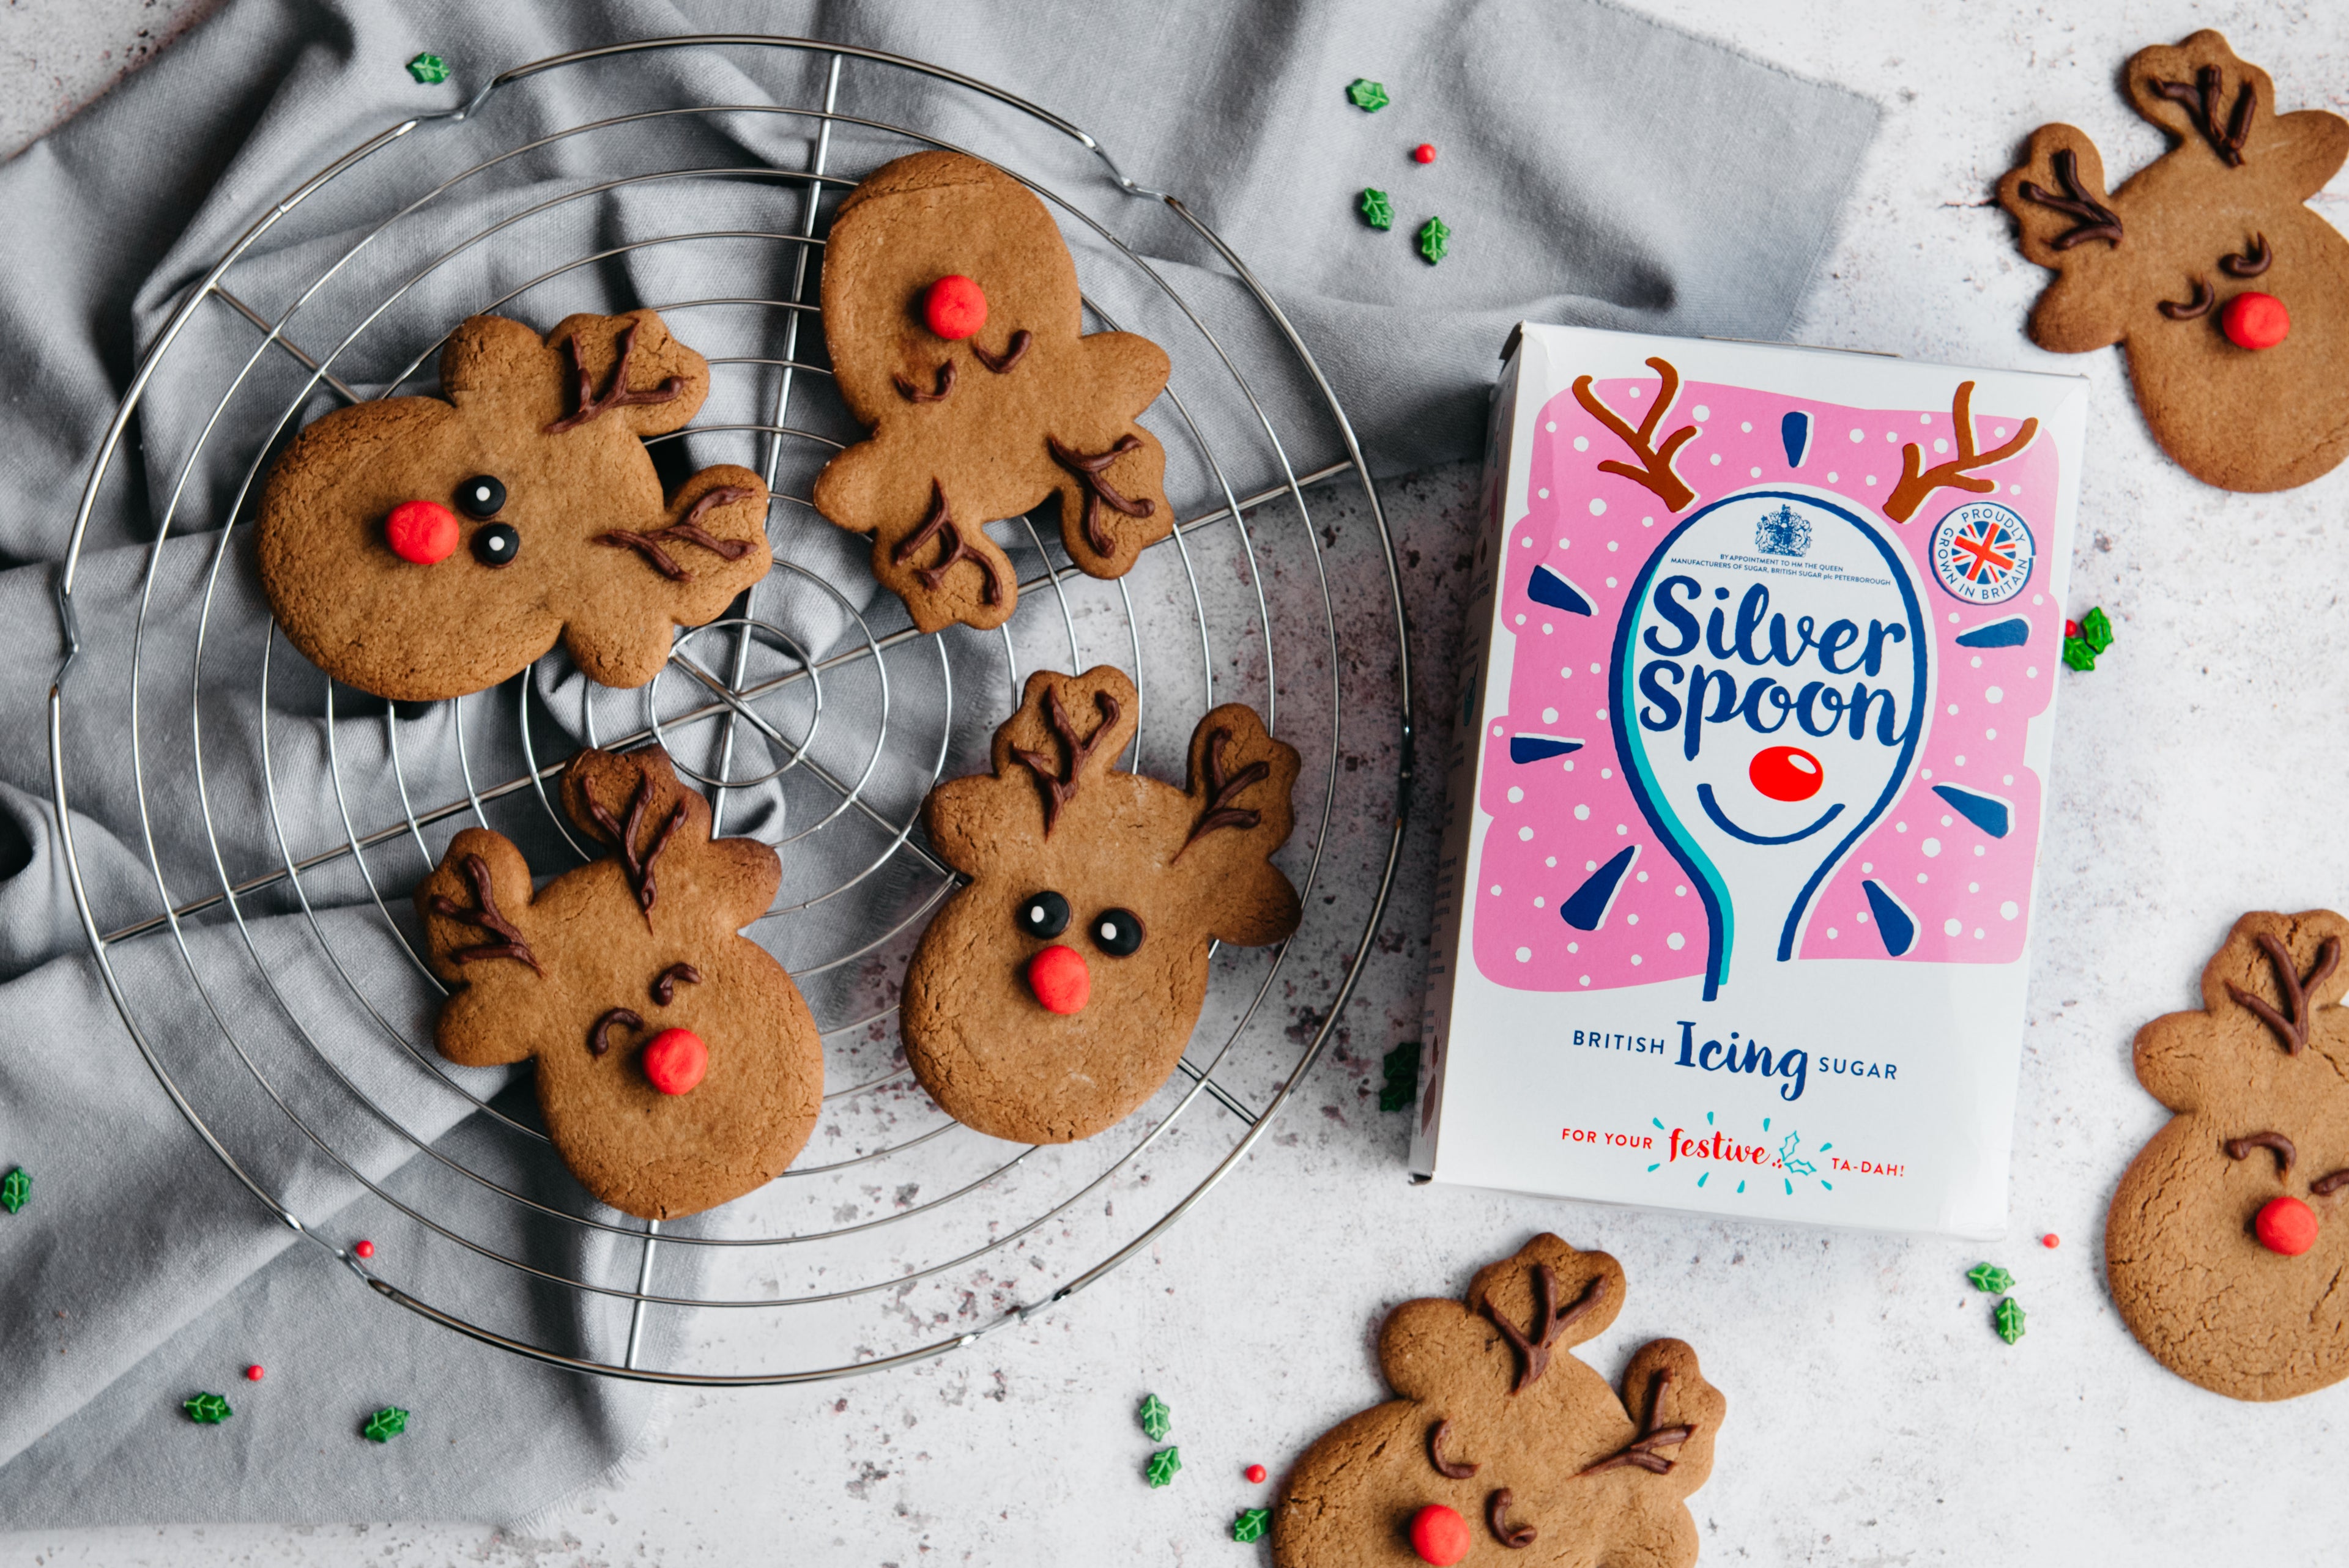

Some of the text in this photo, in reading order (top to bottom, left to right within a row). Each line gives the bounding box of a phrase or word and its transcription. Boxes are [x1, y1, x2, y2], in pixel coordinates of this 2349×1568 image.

[1961, 509, 2025, 542] PROUDLY
[1671, 558, 1731, 568] MANUFACTURERS
[1744, 565, 1769, 574] SUGAR,
[1798, 569, 1822, 578] SUGAR
[1835, 575, 1891, 585] PETERBOROUGH
[1729, 555, 1779, 565] APPOINTMENT
[1938, 528, 2028, 599] GROWN IN BRITAIN
[1644, 575, 1906, 676] Silver
[1573, 1021, 1897, 1101] BRITISH Icing SUGAR
[1562, 1128, 1904, 1177] FOR YOUR festive TA-DAH!
